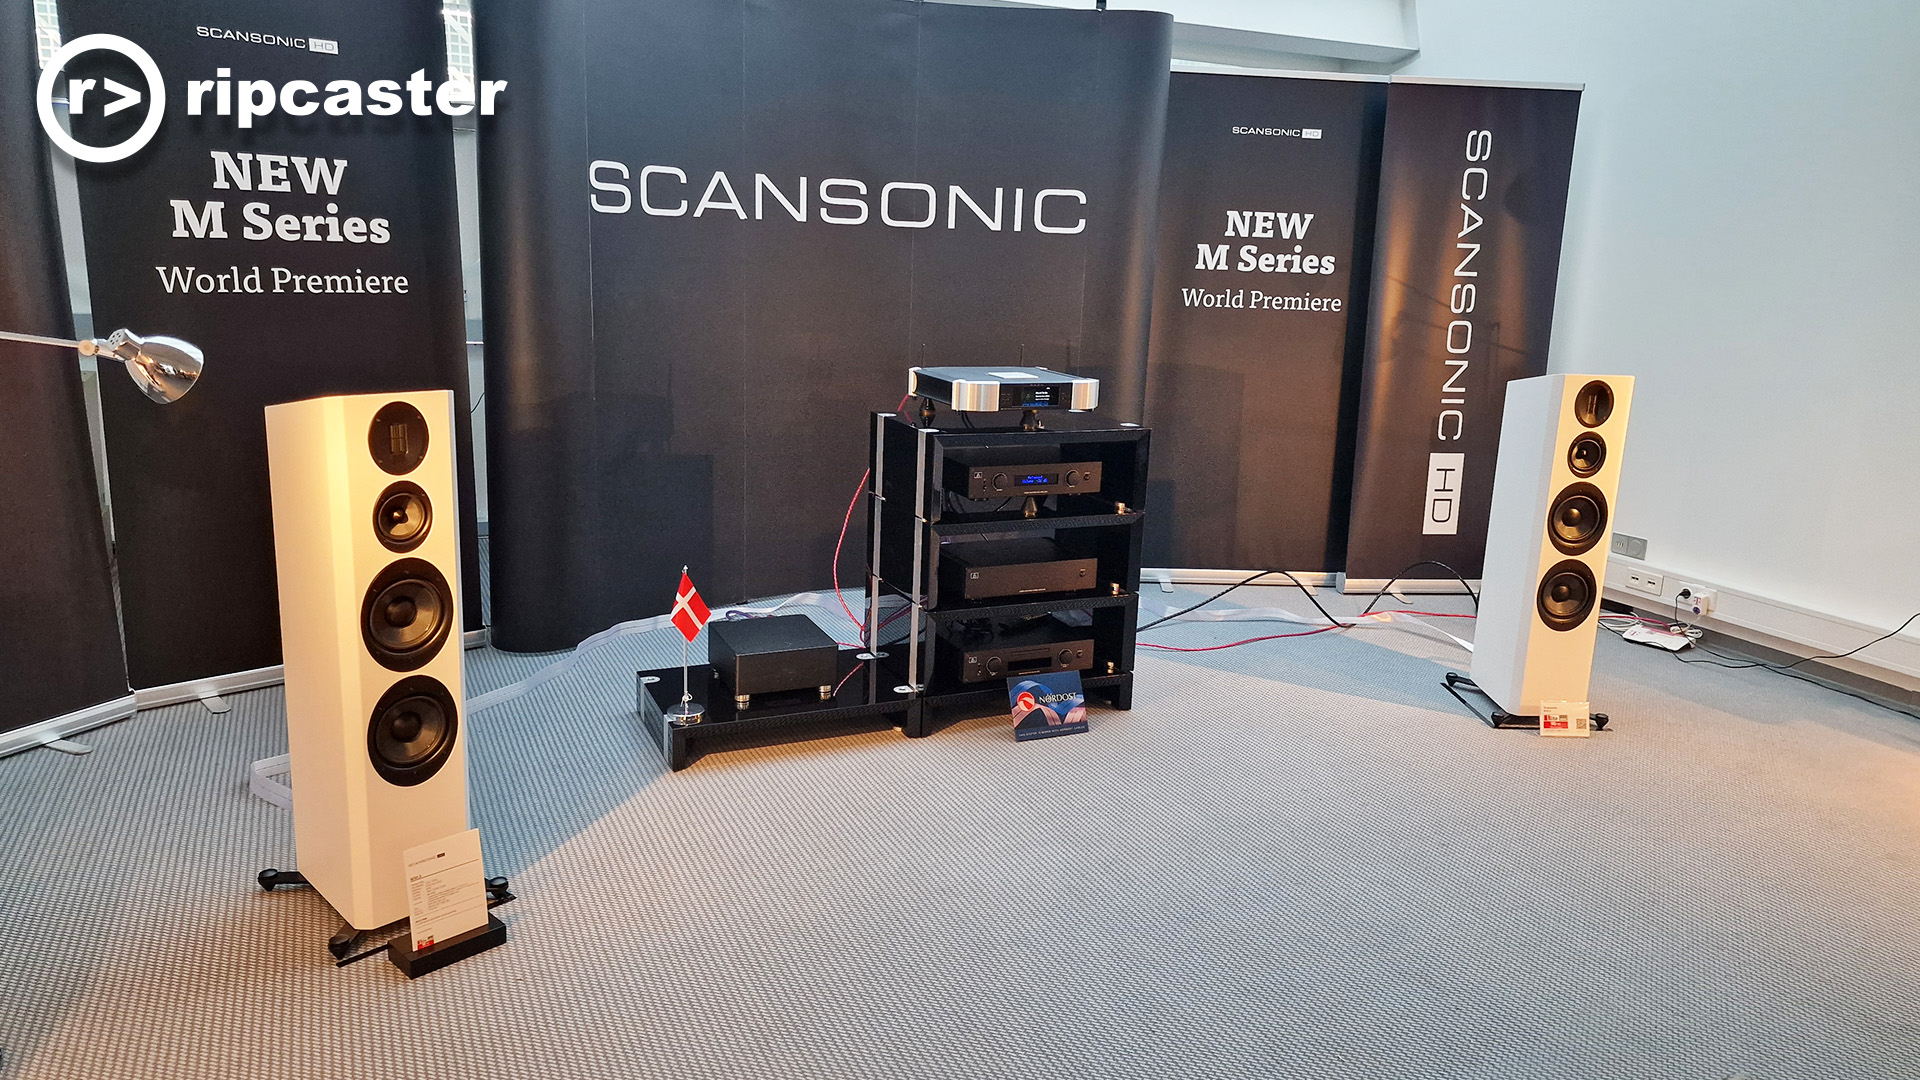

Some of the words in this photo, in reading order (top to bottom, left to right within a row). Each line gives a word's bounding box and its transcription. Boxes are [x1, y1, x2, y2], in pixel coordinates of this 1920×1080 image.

[196, 26, 306, 49] SCANSONIC
[313, 41, 336, 52] HD
[1232, 126, 1301, 137] SCANSONIC
[210, 150, 348, 196] NEW
[589, 159, 1087, 235] SCANSONIC
[169, 199, 229, 239] M
[242, 202, 391, 244] Series
[1224, 210, 1315, 240] NEW
[1194, 243, 1230, 271] M
[1237, 244, 1336, 275] Series
[155, 266, 262, 294] World
[271, 267, 409, 294] Premiere
[1437, 130, 1492, 441] SCANSONIC
[1181, 287, 1245, 309] World
[1248, 290, 1342, 312] Premiere
[1431, 468, 1456, 523] HD
